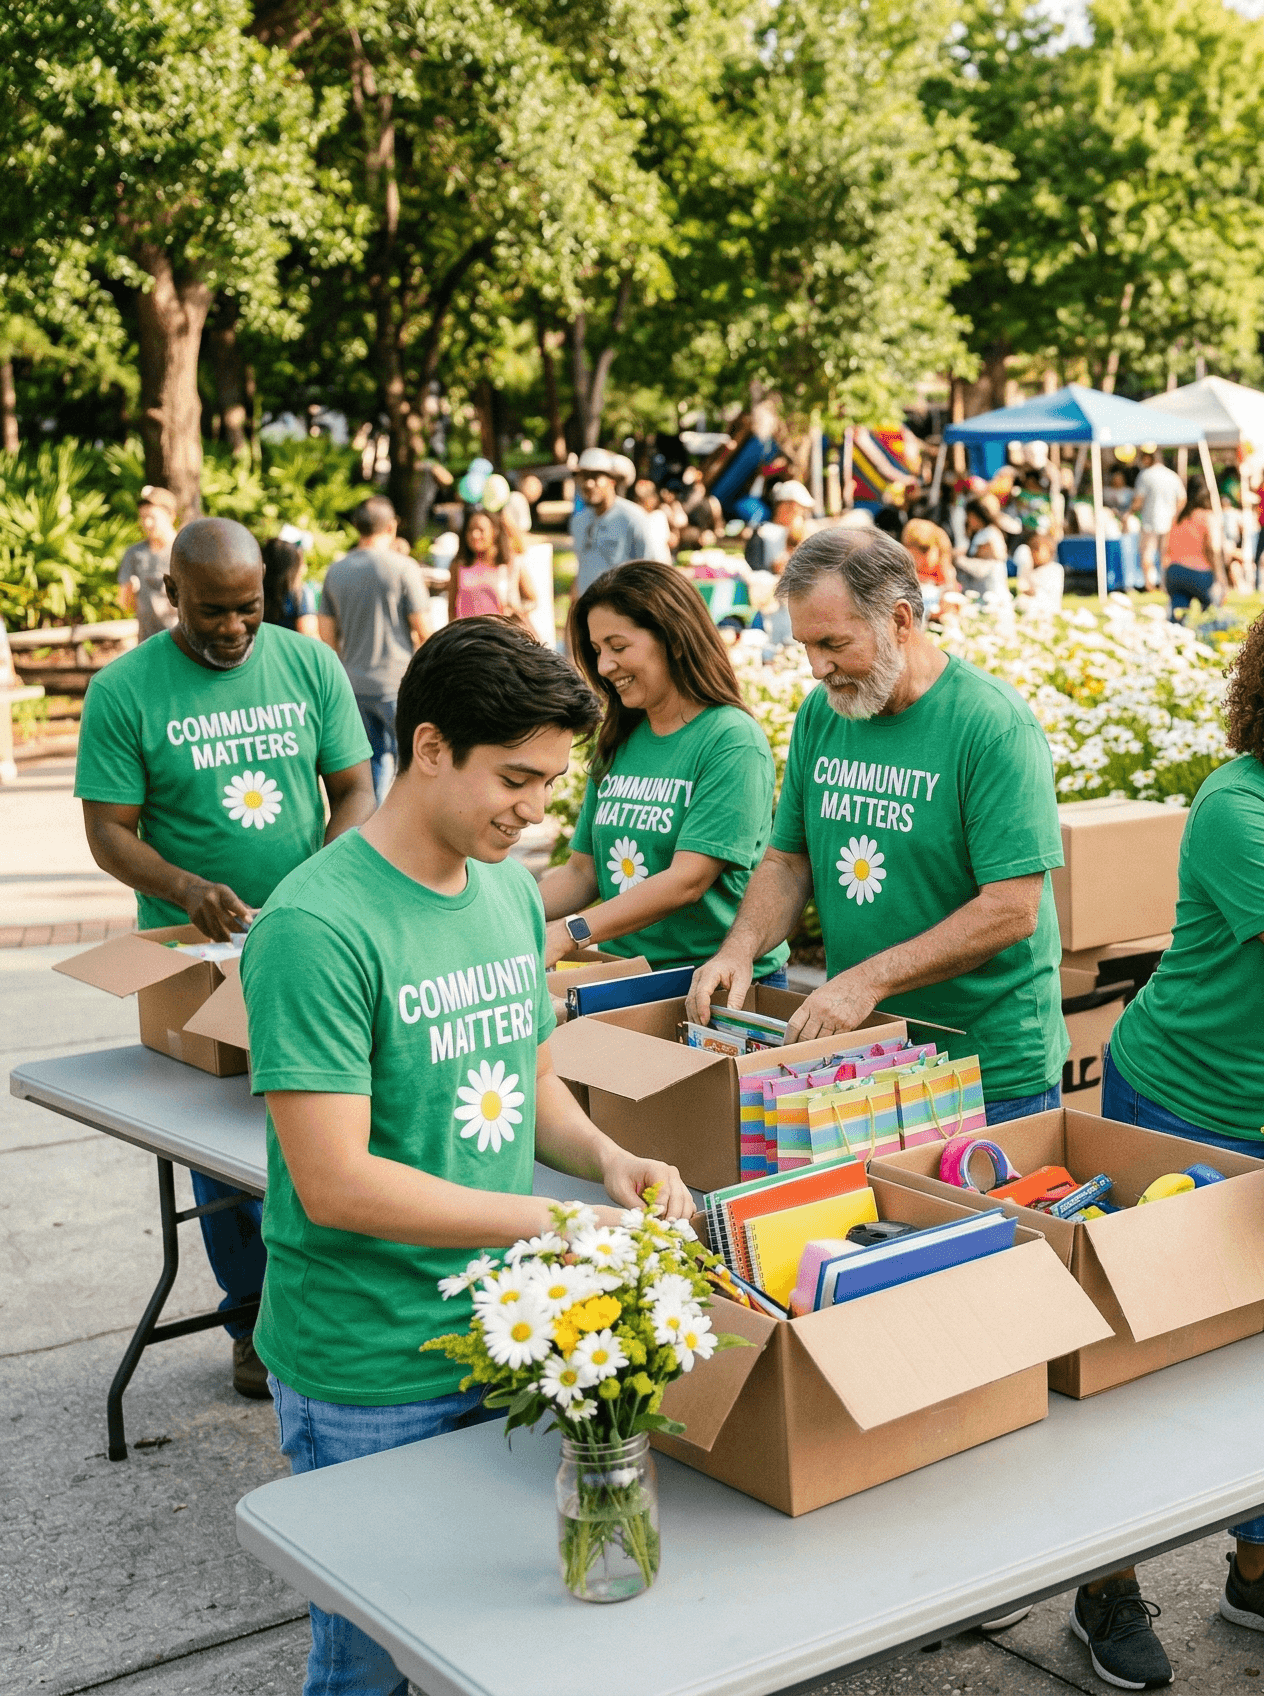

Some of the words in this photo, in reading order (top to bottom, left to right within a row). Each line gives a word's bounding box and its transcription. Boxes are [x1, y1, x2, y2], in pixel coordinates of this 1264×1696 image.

[167, 702, 306, 746] COMMUNITY
[191, 731, 299, 770] MATTERS
[814, 756, 940, 801] COMMUNITY
[595, 801, 674, 834] MATTERS
[820, 790, 914, 833] MATTERS
[398, 953, 537, 1024] COMMUNITY
[429, 998, 533, 1064] MATTERS
